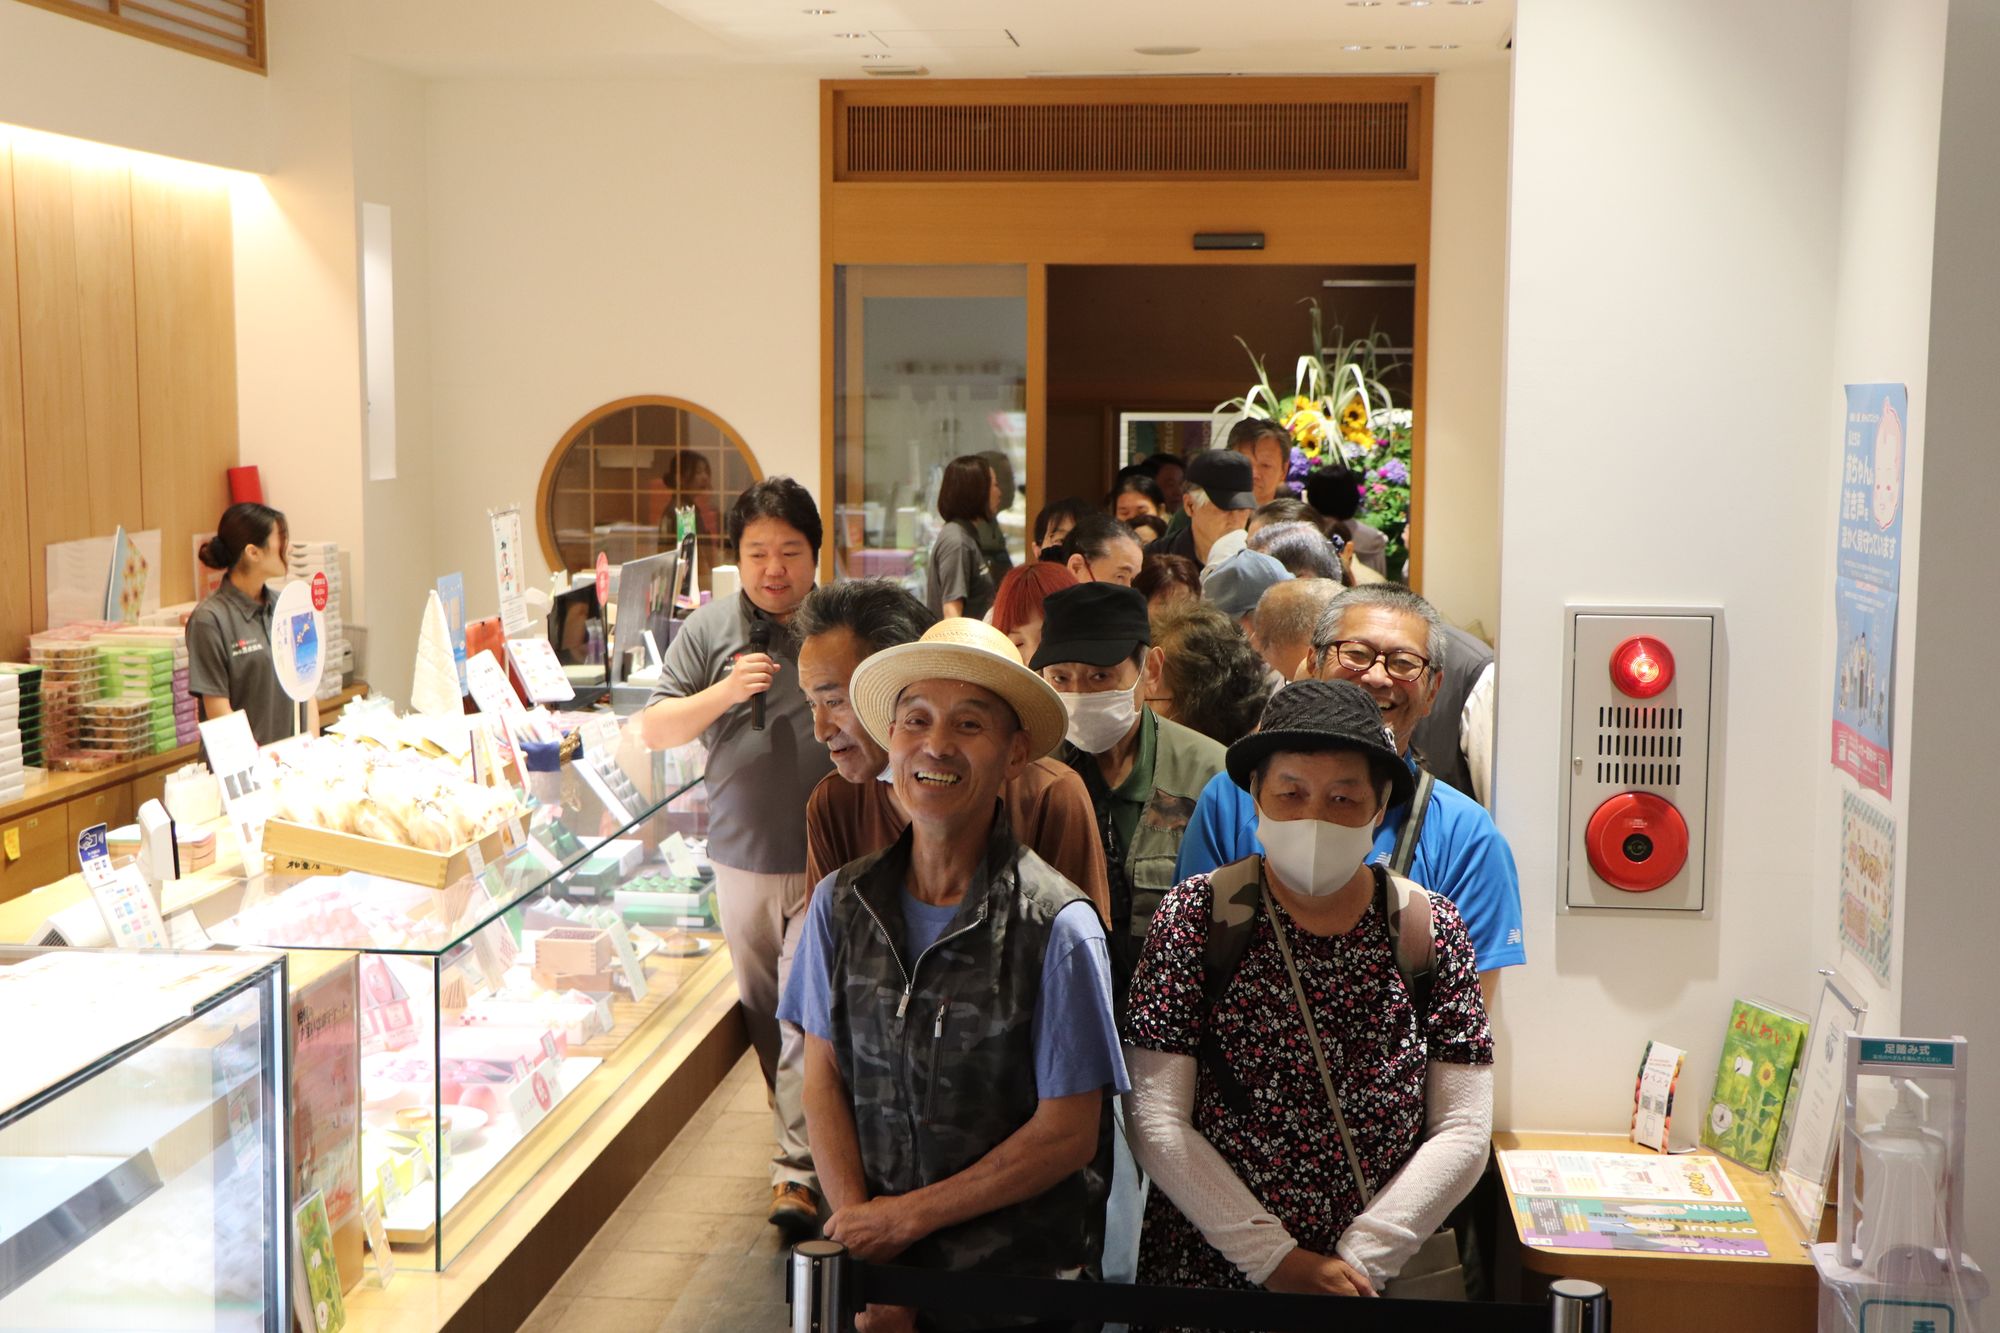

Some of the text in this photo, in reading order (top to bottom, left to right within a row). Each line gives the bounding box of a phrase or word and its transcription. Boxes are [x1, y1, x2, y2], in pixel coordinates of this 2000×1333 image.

[1884, 1043, 1931, 1056] 足踏み式
[1683, 1204, 1748, 1213] INKEN
[1683, 1225, 1758, 1234] OTSUJI
